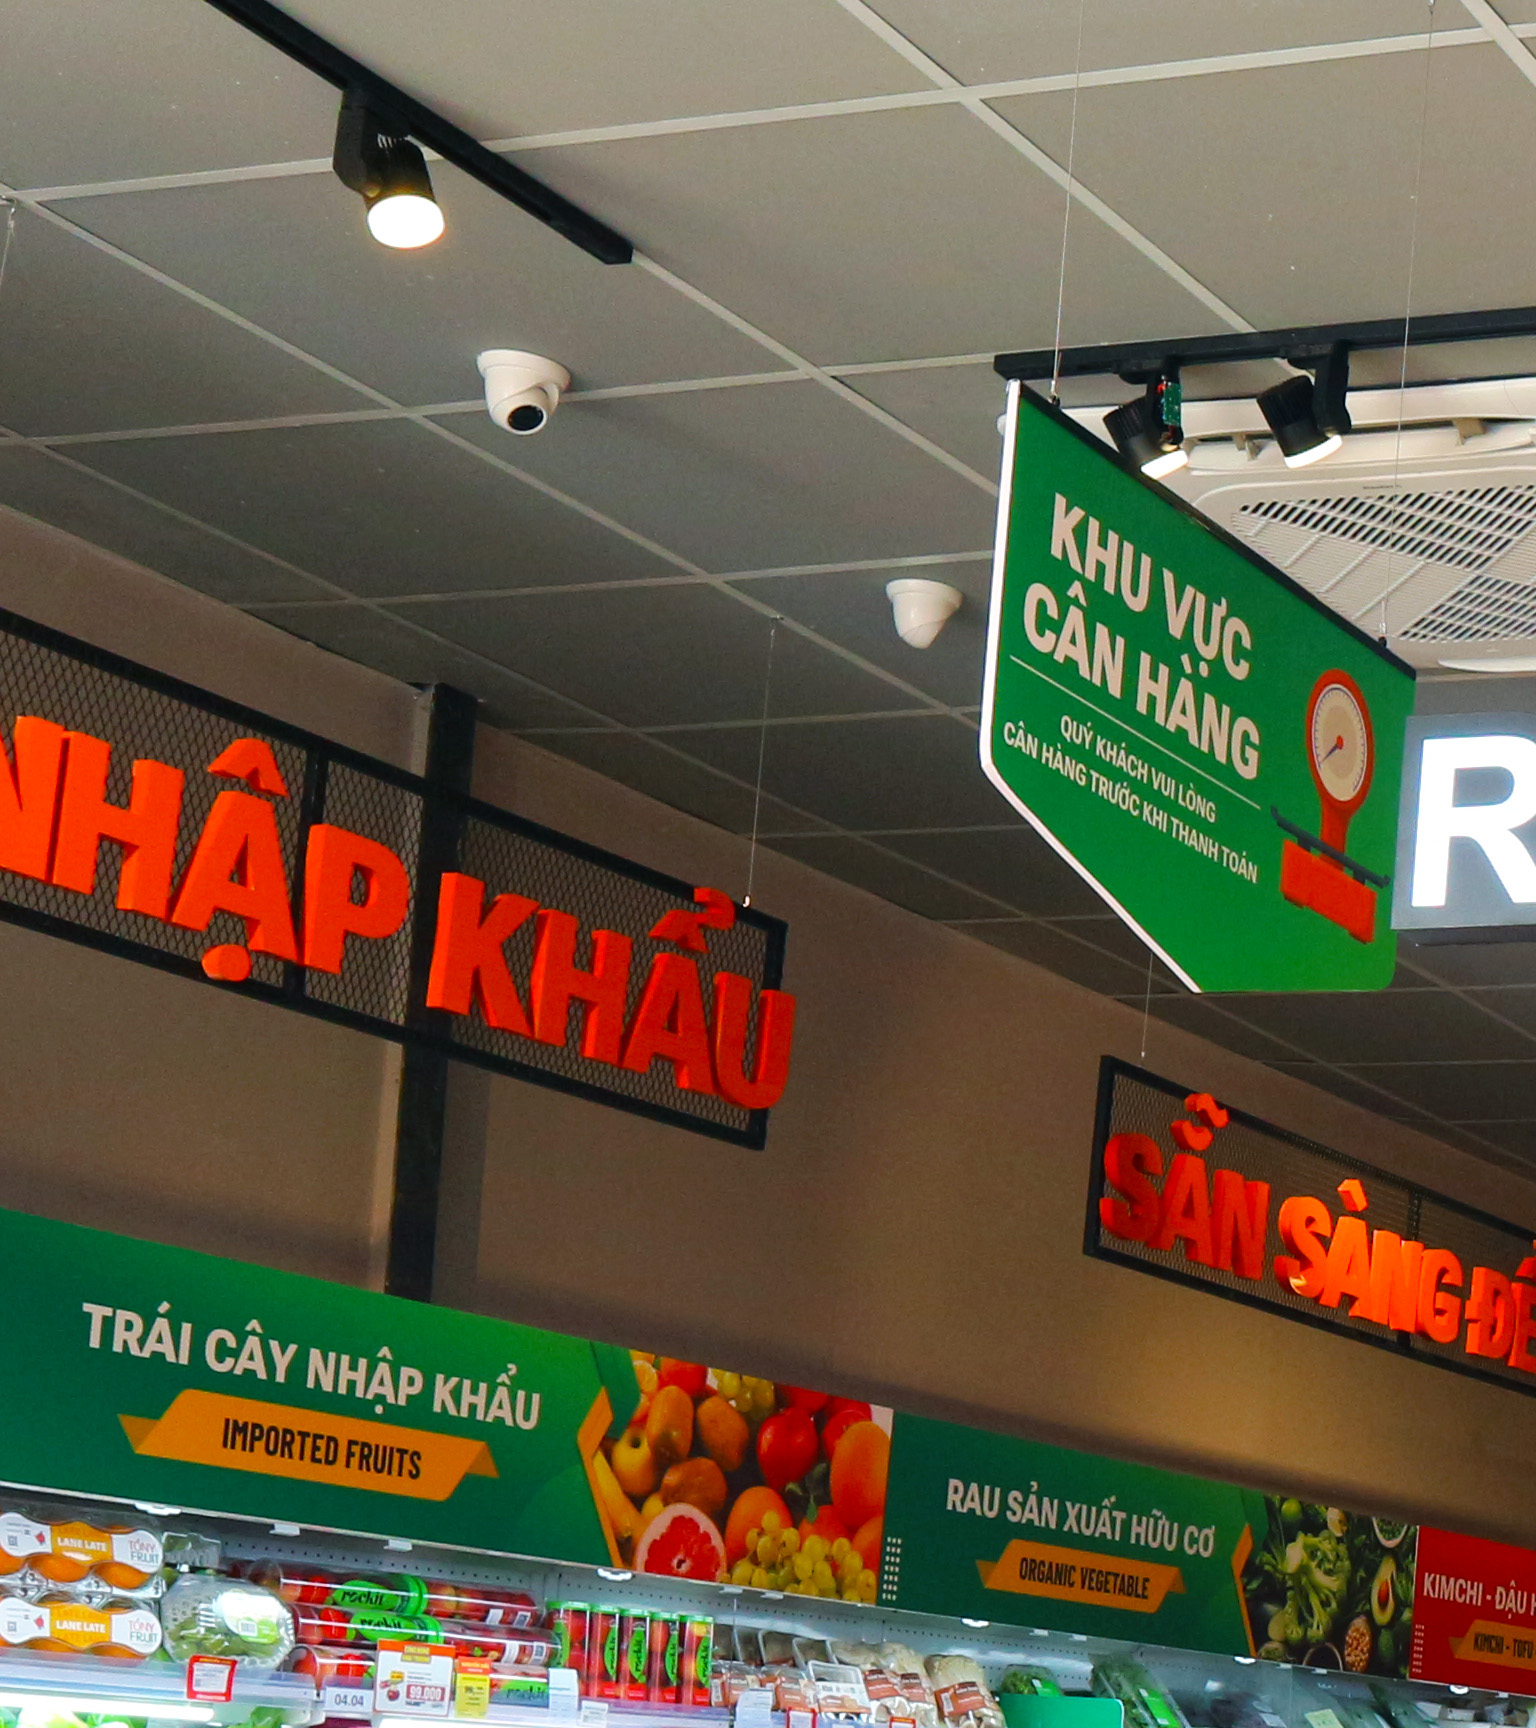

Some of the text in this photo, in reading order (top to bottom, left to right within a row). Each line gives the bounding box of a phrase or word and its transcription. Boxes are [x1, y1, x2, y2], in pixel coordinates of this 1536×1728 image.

[1051, 492, 1252, 681] KHU VỰC
[1023, 579, 1261, 780] CÂN HÀNG
[1060, 714, 1216, 823] QUÝ KHÁCH VUI LÒNG
[1003, 718, 1258, 884] CÂN HÀNG TRƯỚC KHI THANH TOÁN
[0, 716, 796, 1110] NHẬP KHẨU
[1100, 1092, 1270, 1280] SẴN
[1274, 1178, 1463, 1344] SÀNG
[82, 1301, 540, 1431] TRÁI CÂY NHẬP KHẨU
[222, 1417, 421, 1480] IMPORTED FRUITS
[57, 1535, 107, 1553] LANE LATE
[946, 1477, 1215, 1558] RAU SẢN XUẤT HỮU CƠ
[130, 1550, 159, 1566] FRUIT
[1018, 1556, 1150, 1601] ORGANIC VEGETABLE
[55, 1619, 106, 1634] LANE LATE
[1423, 1572, 1483, 1606] KIMCHI
[1495, 1580, 1527, 1620] ĐẬU
[129, 1630, 158, 1645] FRUIT
[1473, 1632, 1504, 1654] KIMCHI
[334, 1693, 365, 1707] 04.04
